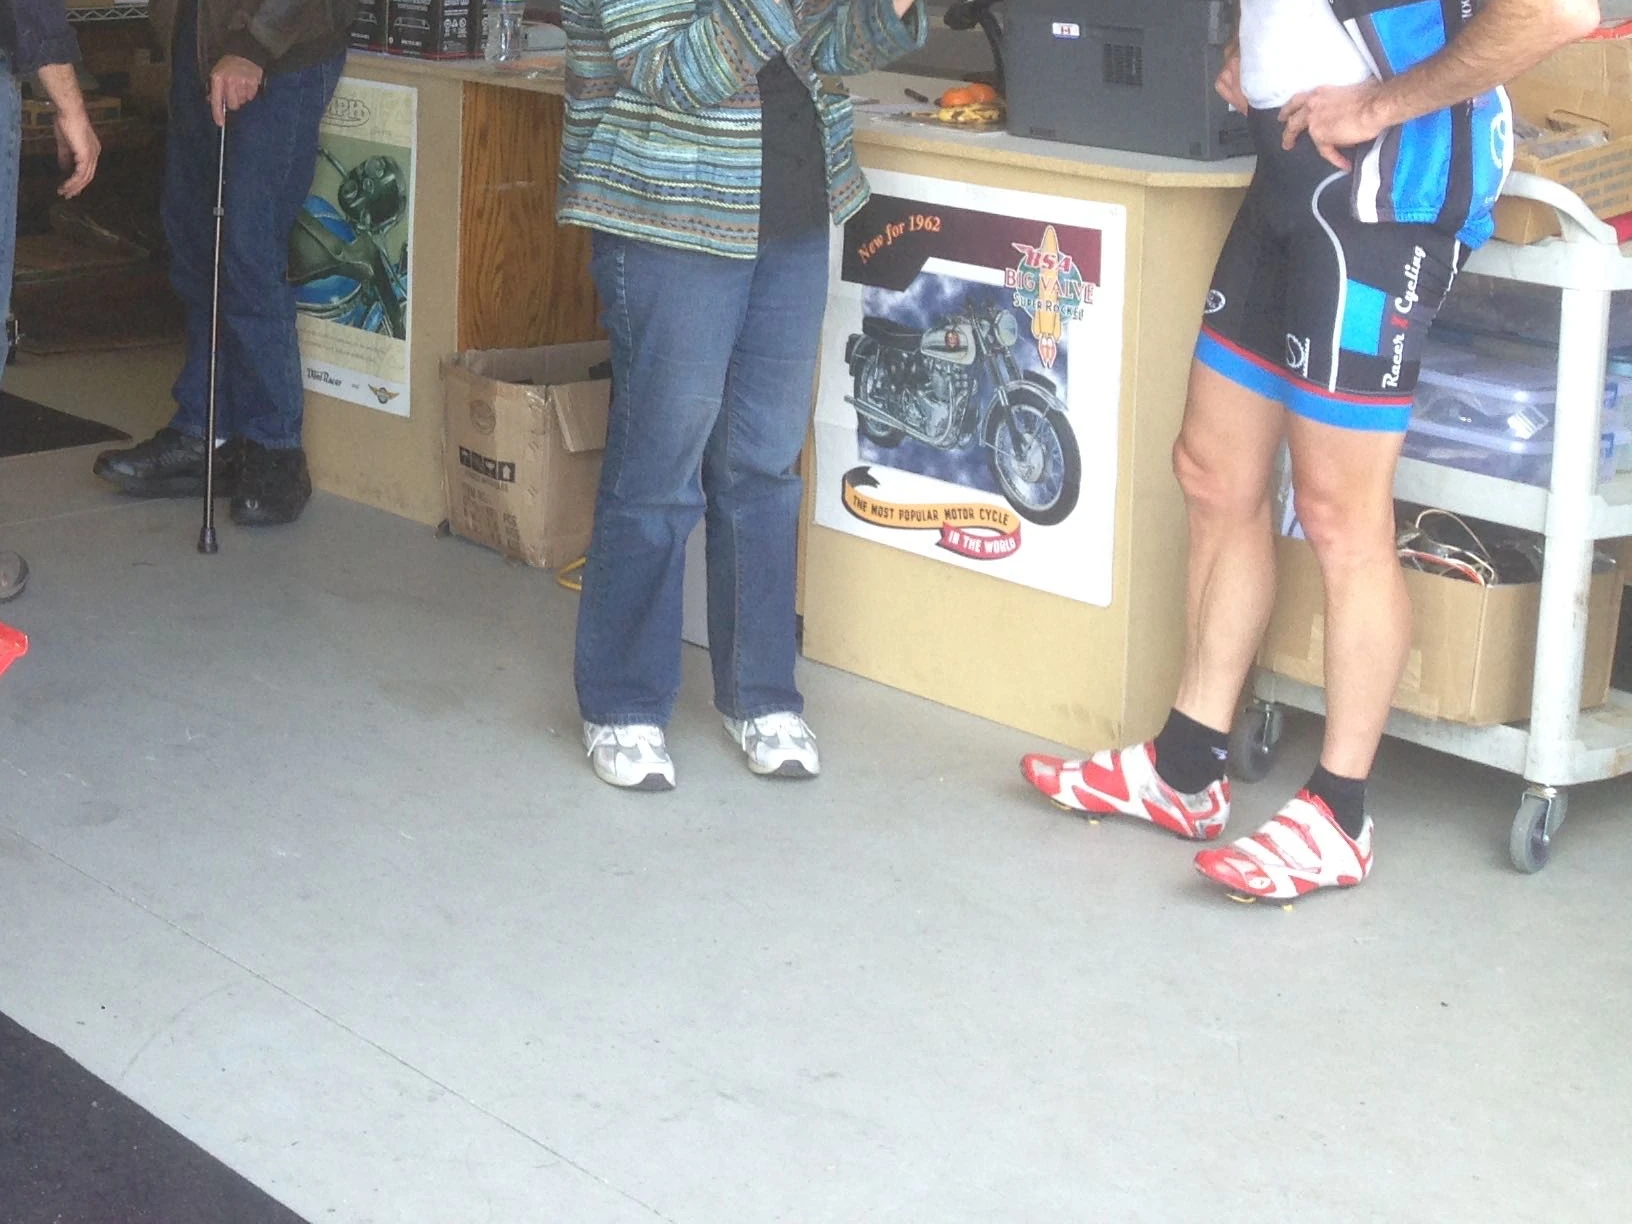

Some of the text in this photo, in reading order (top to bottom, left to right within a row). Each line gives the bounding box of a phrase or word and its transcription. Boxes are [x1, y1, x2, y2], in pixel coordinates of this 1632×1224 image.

[857, 214, 941, 265] New for 1962
[1016, 244, 1073, 273] BSA
[1004, 267, 1096, 304] BIG VALVE
[1394, 245, 1427, 314] Cycling
[1012, 292, 1085, 321] SUPER ROCKET
[1381, 332, 1405, 389] Racer
[853, 495, 1011, 526] THE MOST POPULAR MOTOR CYCLE
[948, 531, 1017, 554] IN THE WORLD
